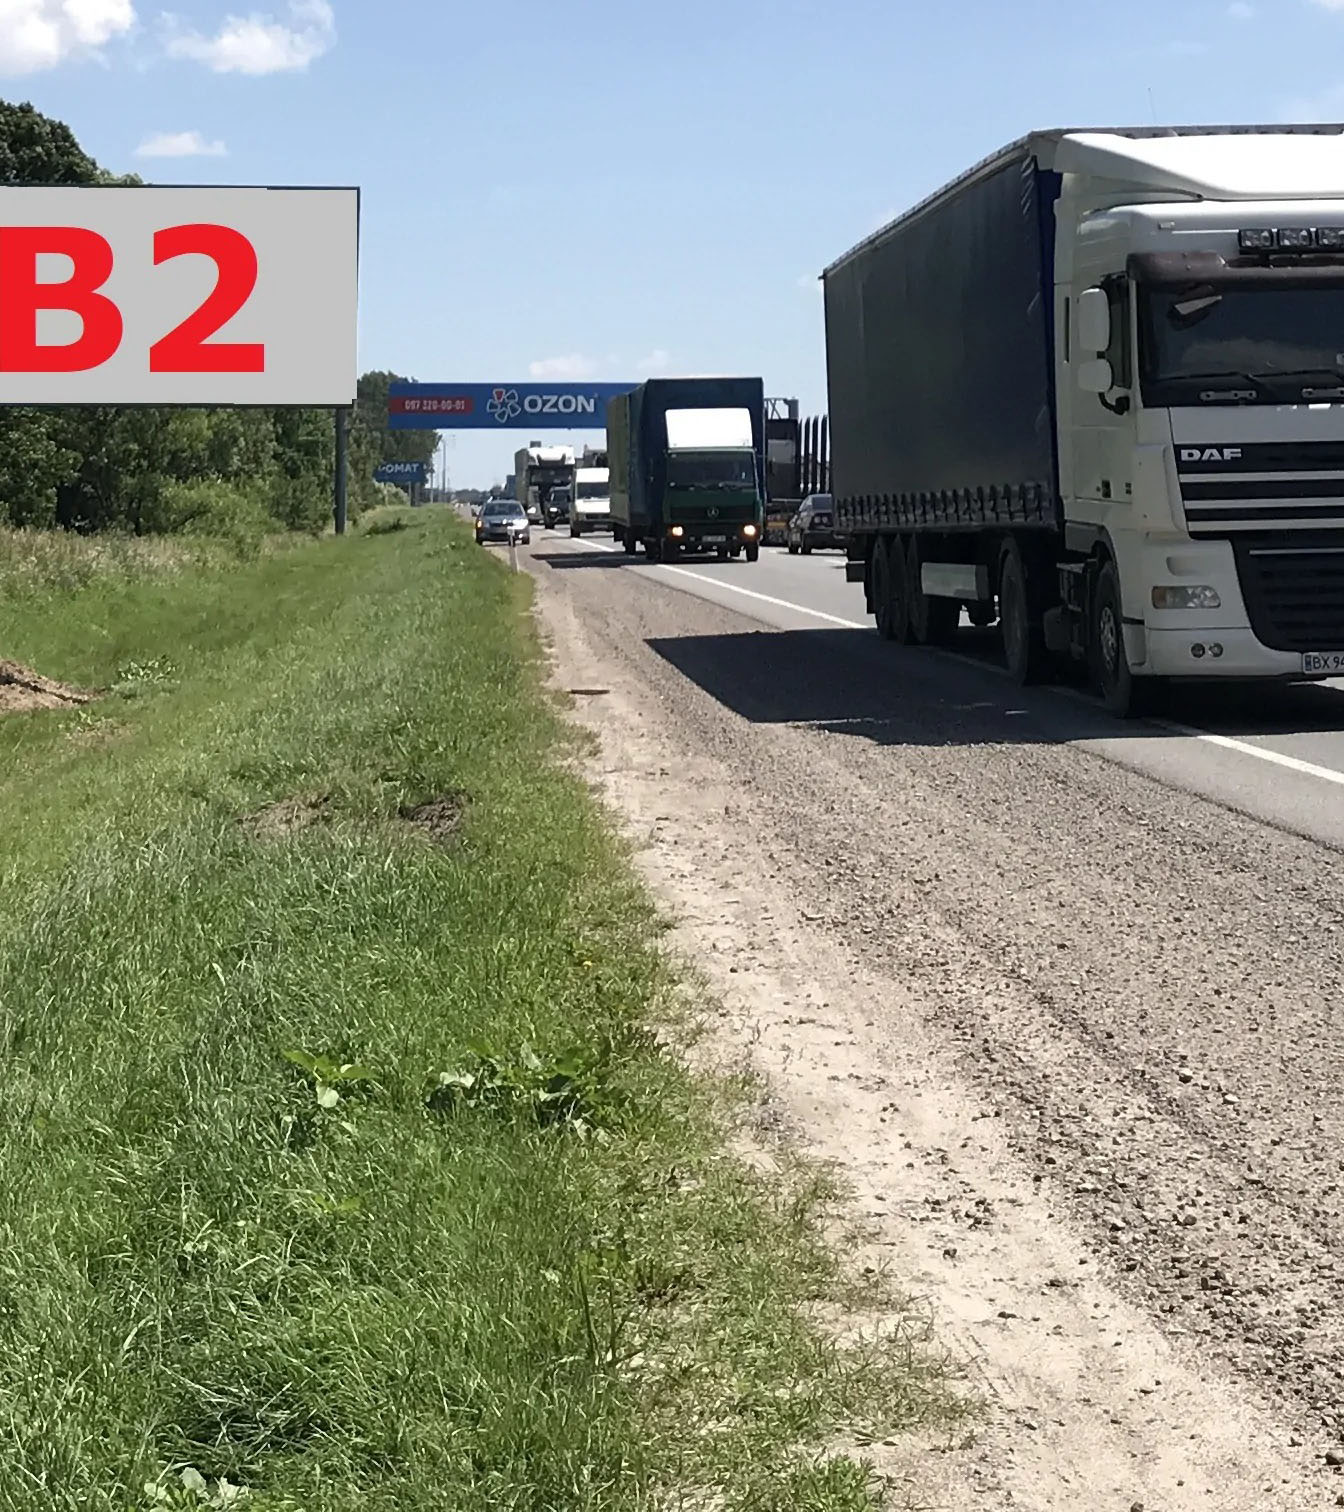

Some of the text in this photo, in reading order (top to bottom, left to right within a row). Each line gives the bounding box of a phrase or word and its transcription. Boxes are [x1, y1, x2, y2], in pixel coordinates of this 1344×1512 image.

[524, 394, 595, 413] OZON
[1180, 448, 1242, 462] DAF
[1312, 656, 1330, 670] BX
